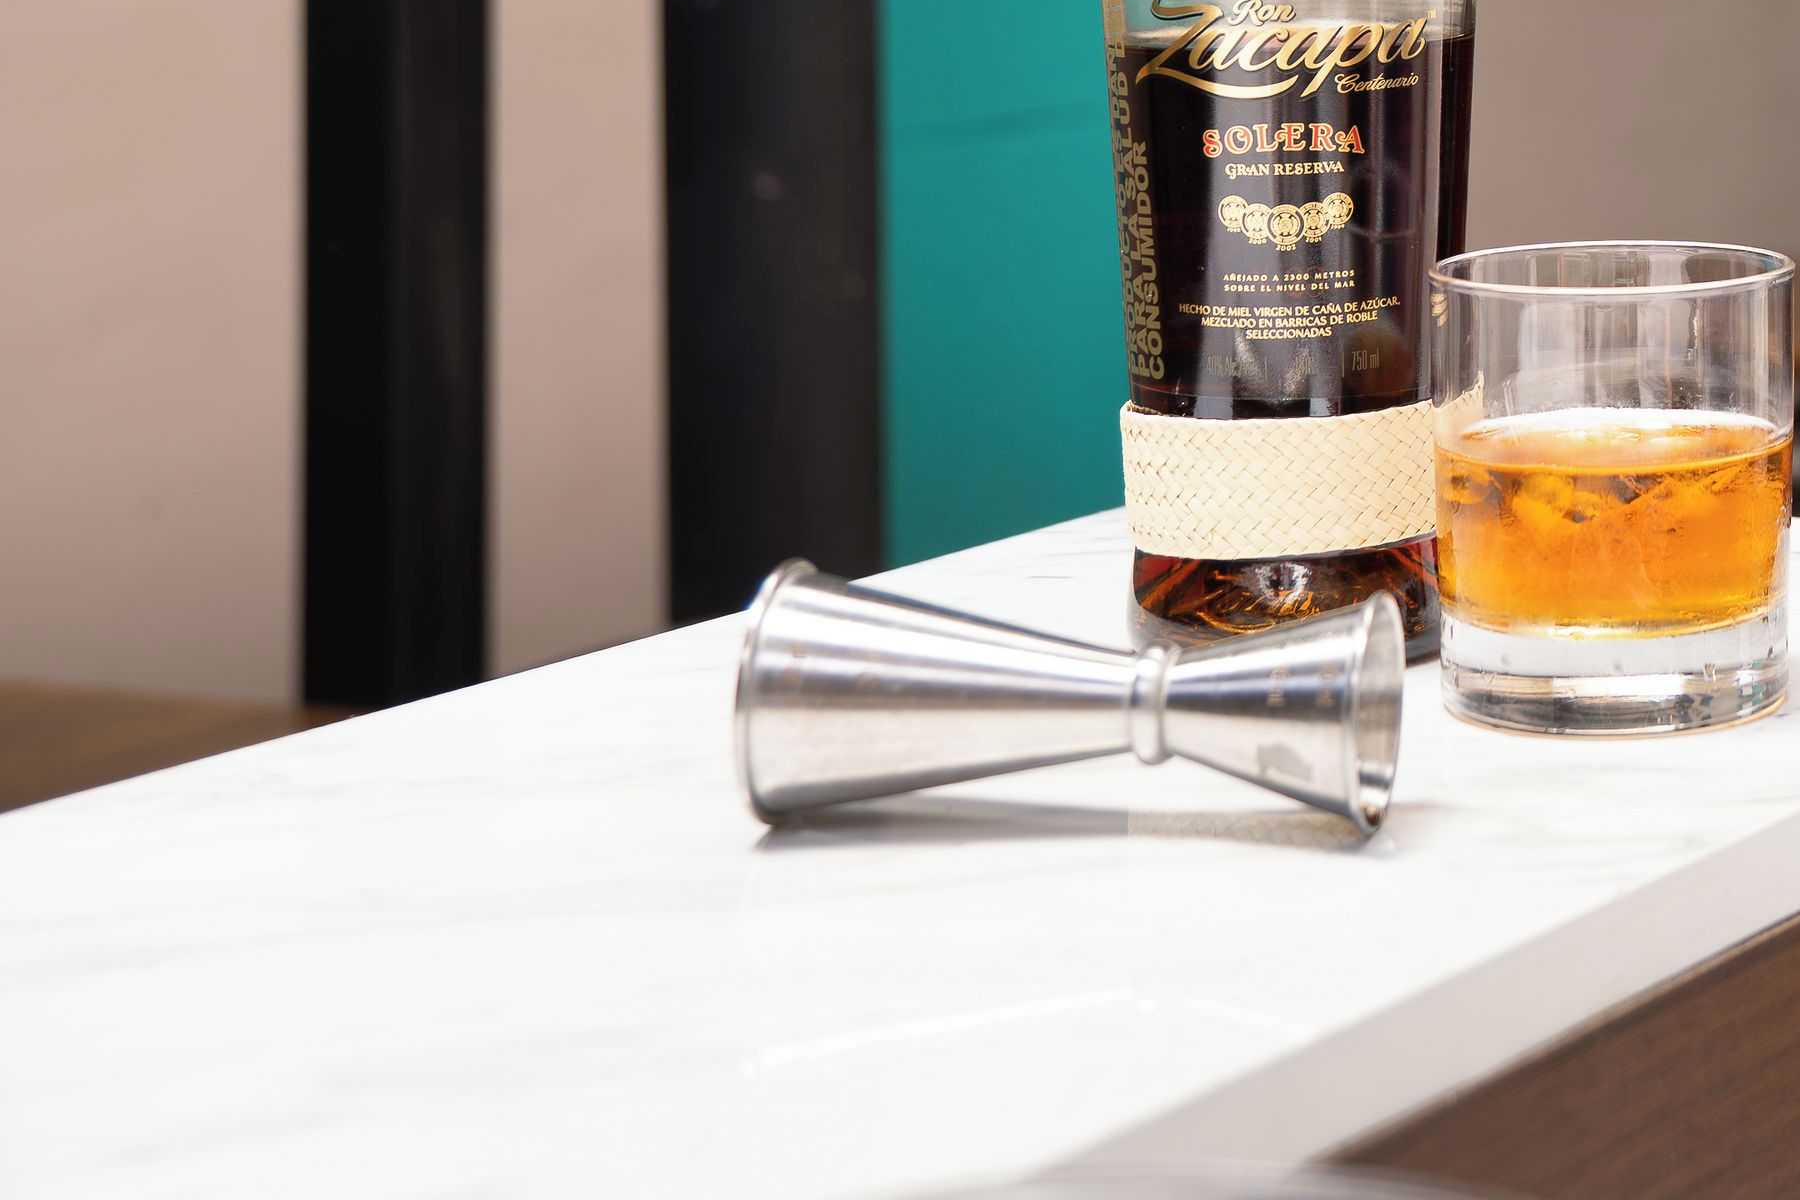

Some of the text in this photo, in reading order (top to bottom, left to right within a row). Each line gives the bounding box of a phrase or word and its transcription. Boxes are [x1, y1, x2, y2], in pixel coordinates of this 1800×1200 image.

[1335, 72, 1419, 94] Centenario
[1202, 122, 1365, 158] SOLERA
[1225, 160, 1345, 180] GRAN RESERVA
[1117, 71, 1150, 377] PARA LA SALUD
[1275, 243, 1297, 252] 2002
[1132, 141, 1165, 379] CONSUMIDOR
[1119, 184, 1139, 376] PRODUCTO
[1223, 269, 1355, 282] AÑEJADO A 2300 METROS
[1223, 280, 1356, 292] SOBRE EL NIVEL DEL MAR
[1179, 304, 1211, 315] HECHO
[1212, 305, 1226, 316] DE
[1227, 306, 1252, 317] MIEL
[1253, 307, 1293, 317] VIRGEN
[1294, 305, 1310, 316] DE
[1312, 303, 1342, 315] CAÑA
[1344, 302, 1358, 313] DE
[1201, 310, 1378, 328] MEZCLADO EN BARRICAS DE ROBLE
[1245, 327, 1332, 340] SELECCIONADAS
[1351, 348, 1380, 371] 750 ml
